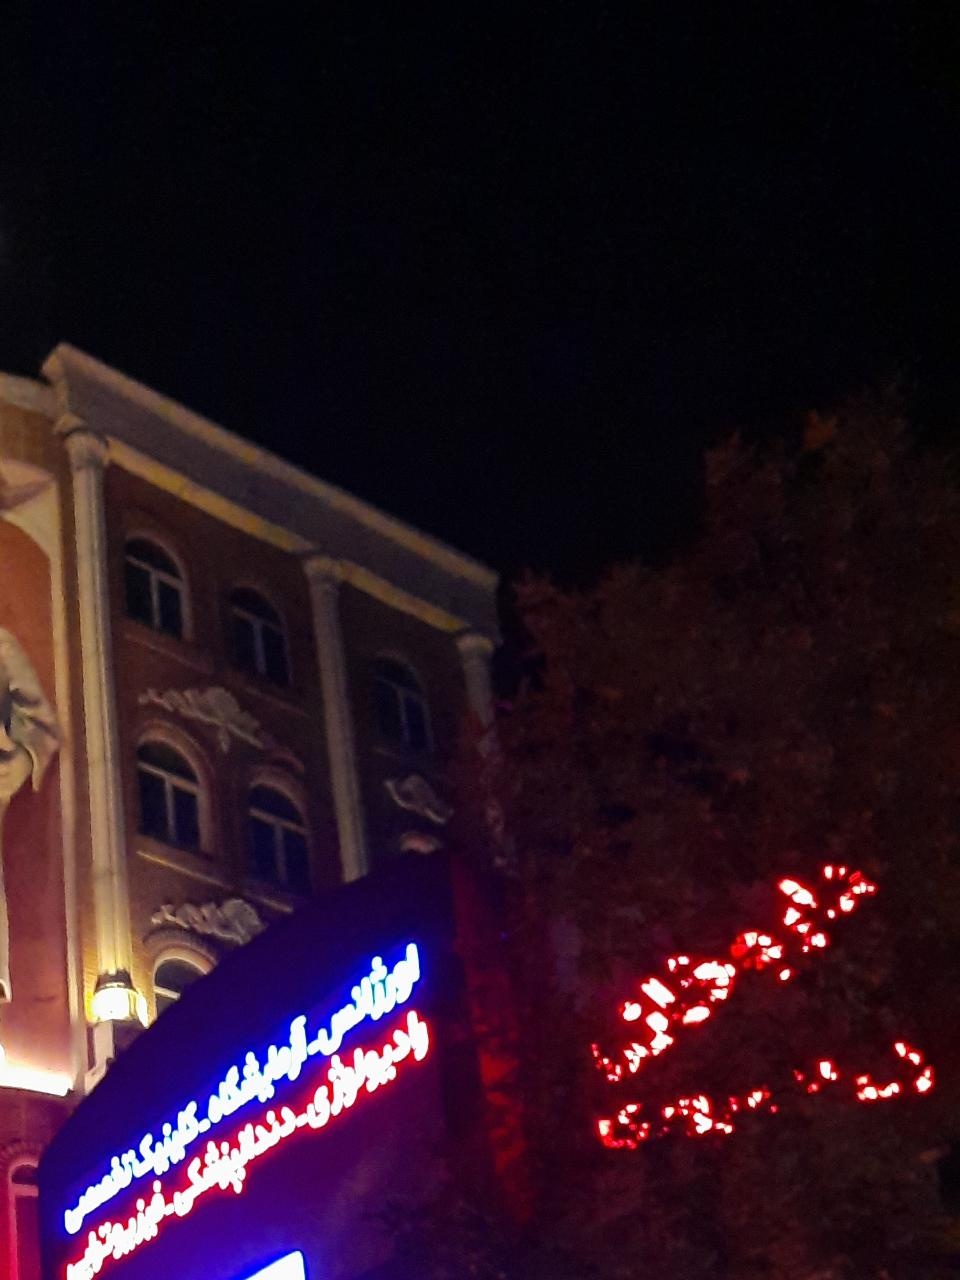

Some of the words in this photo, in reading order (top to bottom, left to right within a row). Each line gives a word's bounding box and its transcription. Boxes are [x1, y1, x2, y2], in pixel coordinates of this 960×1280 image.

[319, 942, 420, 1056] اورژانس
[208, 1014, 307, 1123] آزمایشگاه
[306, 1010, 429, 1129] رادیولوژی
[64, 1149, 136, 1234] تخصصی
[132, 1100, 199, 1175] کلینیک
